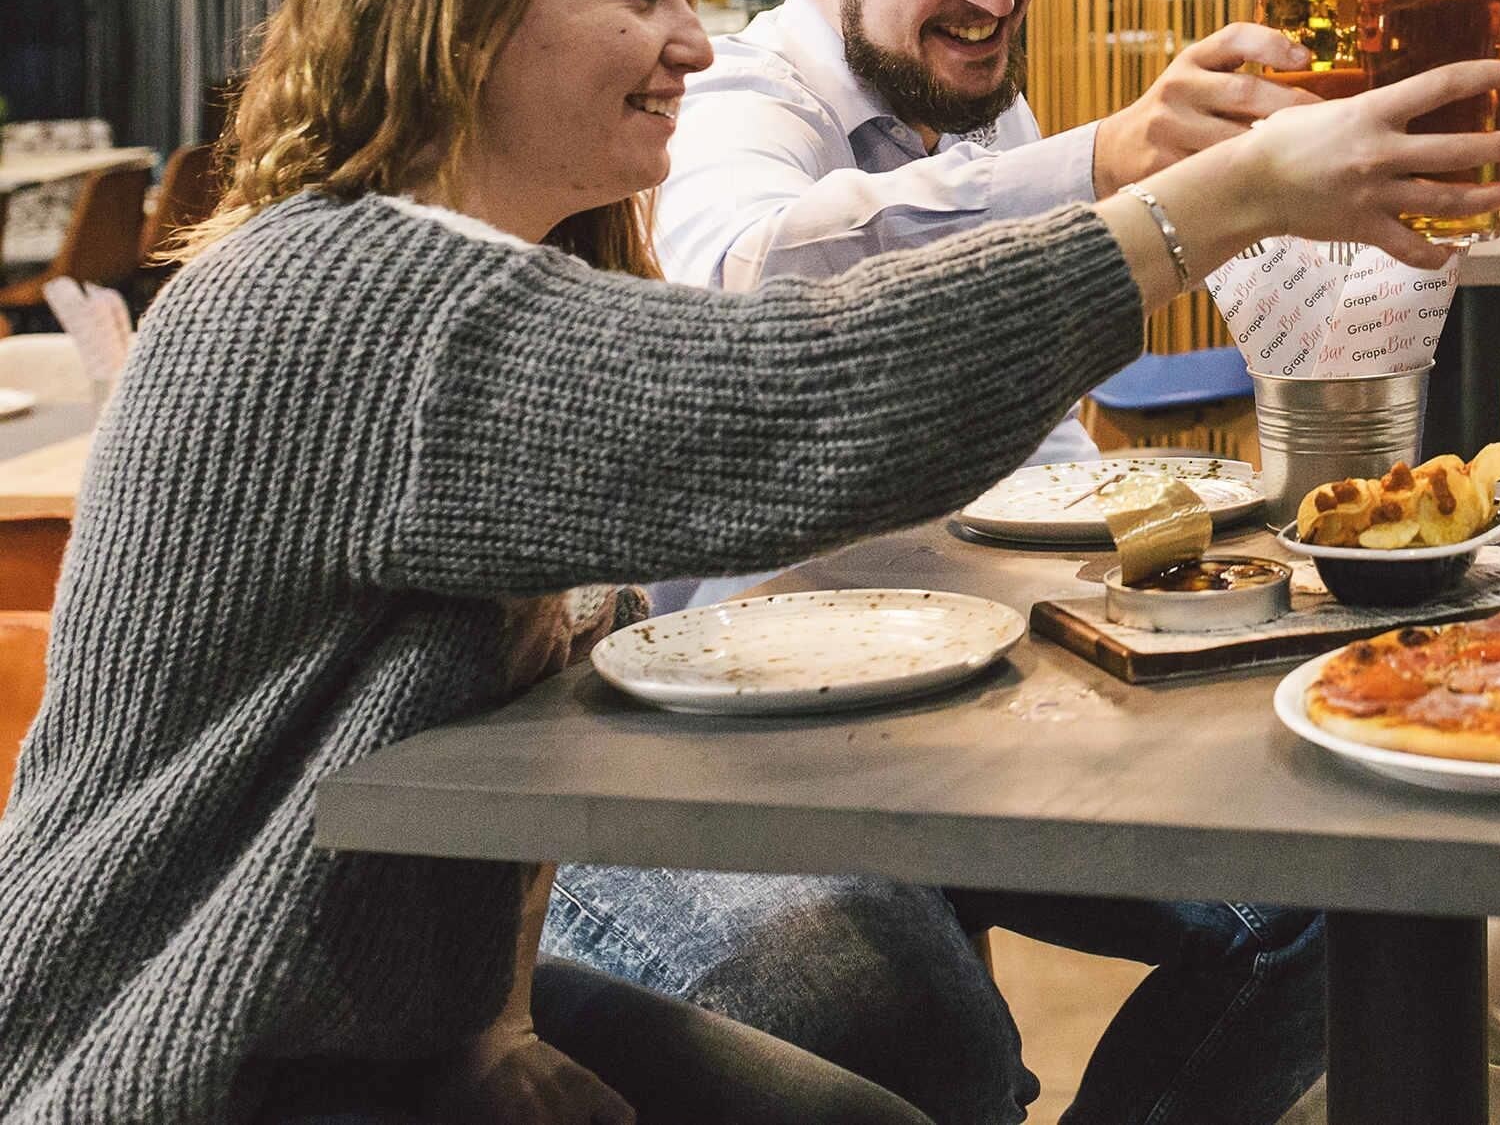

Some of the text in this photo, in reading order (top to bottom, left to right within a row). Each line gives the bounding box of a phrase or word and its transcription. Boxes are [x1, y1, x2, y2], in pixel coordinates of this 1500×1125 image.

[1261, 248, 1287, 273] Grape
[1283, 266, 1308, 290] Grape
[1413, 279, 1447, 292] Grape
[1343, 281, 1406, 308] Grape Bar
[1224, 299, 1244, 322] rape
[1238, 287, 1281, 344] Grape Bar
[1347, 320, 1382, 335] Grape
[1382, 307, 1411, 327] Bar
[1260, 305, 1302, 360] Grape Bar
[1282, 323, 1323, 376] Grape Bar
[1352, 335, 1416, 362] Grape Bar
